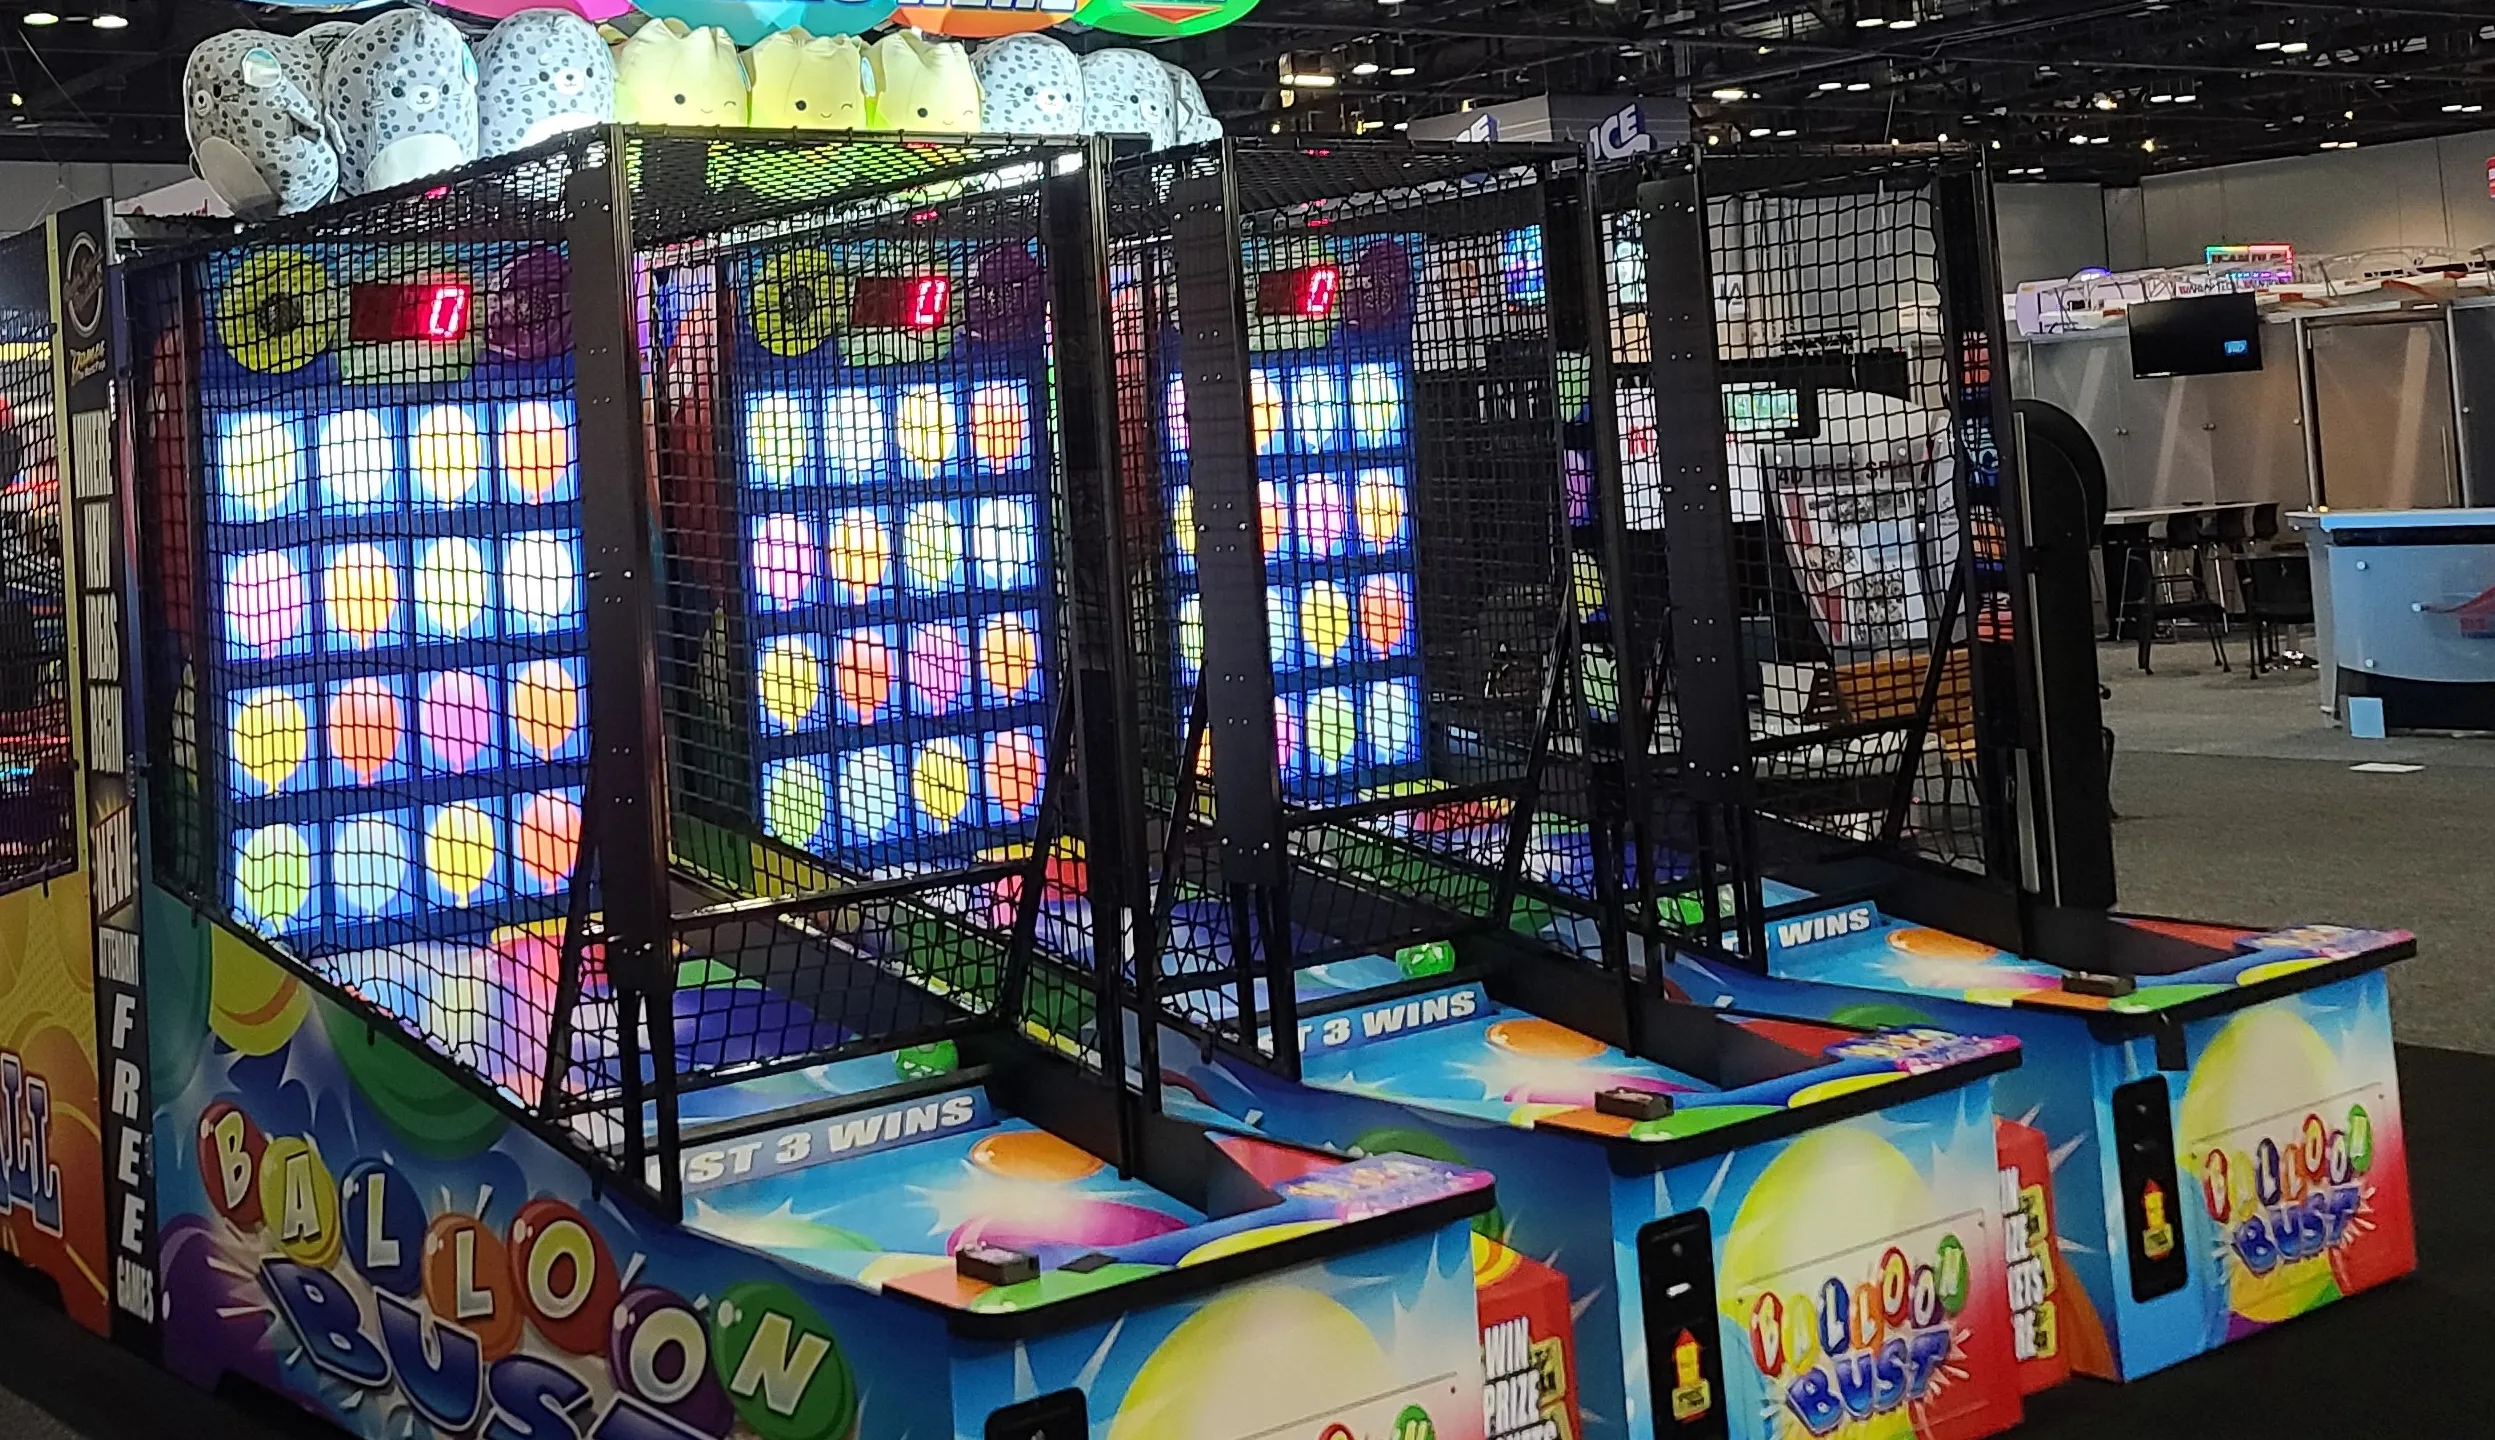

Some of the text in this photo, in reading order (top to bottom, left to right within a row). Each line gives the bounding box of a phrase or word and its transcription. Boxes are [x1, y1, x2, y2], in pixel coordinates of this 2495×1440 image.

[1588, 103, 1651, 160] ICE
[429, 287, 466, 338] 0
[1307, 267, 1337, 315] 0
[85, 592, 119, 681] IDEAS
[94, 803, 132, 919] NEW
[1778, 908, 1870, 948] WINS
[1321, 1017, 1351, 1047] 3
[1362, 991, 1477, 1038] WINS
[111, 993, 148, 1255] FREE
[776, 1132, 812, 1164] 3
[828, 1095, 975, 1152] WINS
[215, 1110, 832, 1419] BALLOON
[2231, 1183, 2363, 1278] BUST
[115, 1254, 155, 1325] GAMES
[1484, 1316, 1530, 1381] WIN
[1785, 1326, 1953, 1438] BUST
[1483, 1368, 1541, 1438] PRIZE
